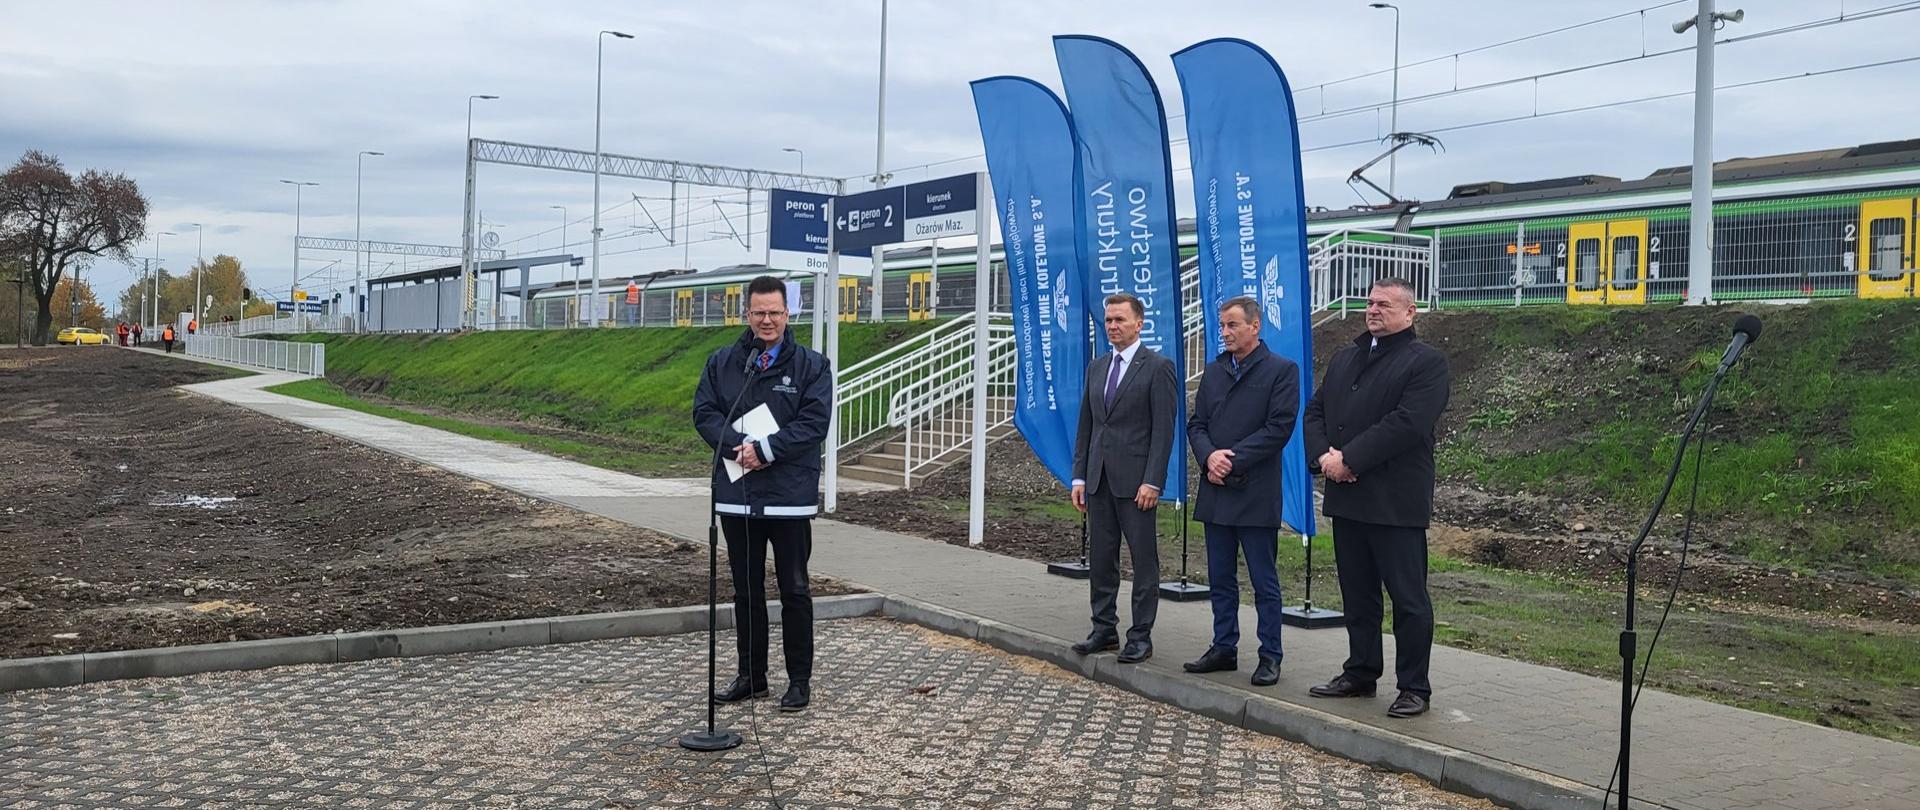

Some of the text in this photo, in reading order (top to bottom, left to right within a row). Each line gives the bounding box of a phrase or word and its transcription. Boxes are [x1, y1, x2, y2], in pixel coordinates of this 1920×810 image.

[786, 200, 828, 222] peron 1
[860, 204, 893, 228] peron 2
[915, 219, 963, 235] Ożarów Maz.
[1844, 223, 1856, 242] 2
[1557, 243, 1566, 258] 2
[1651, 236, 1660, 253] 2
[806, 257, 829, 268] Błon
